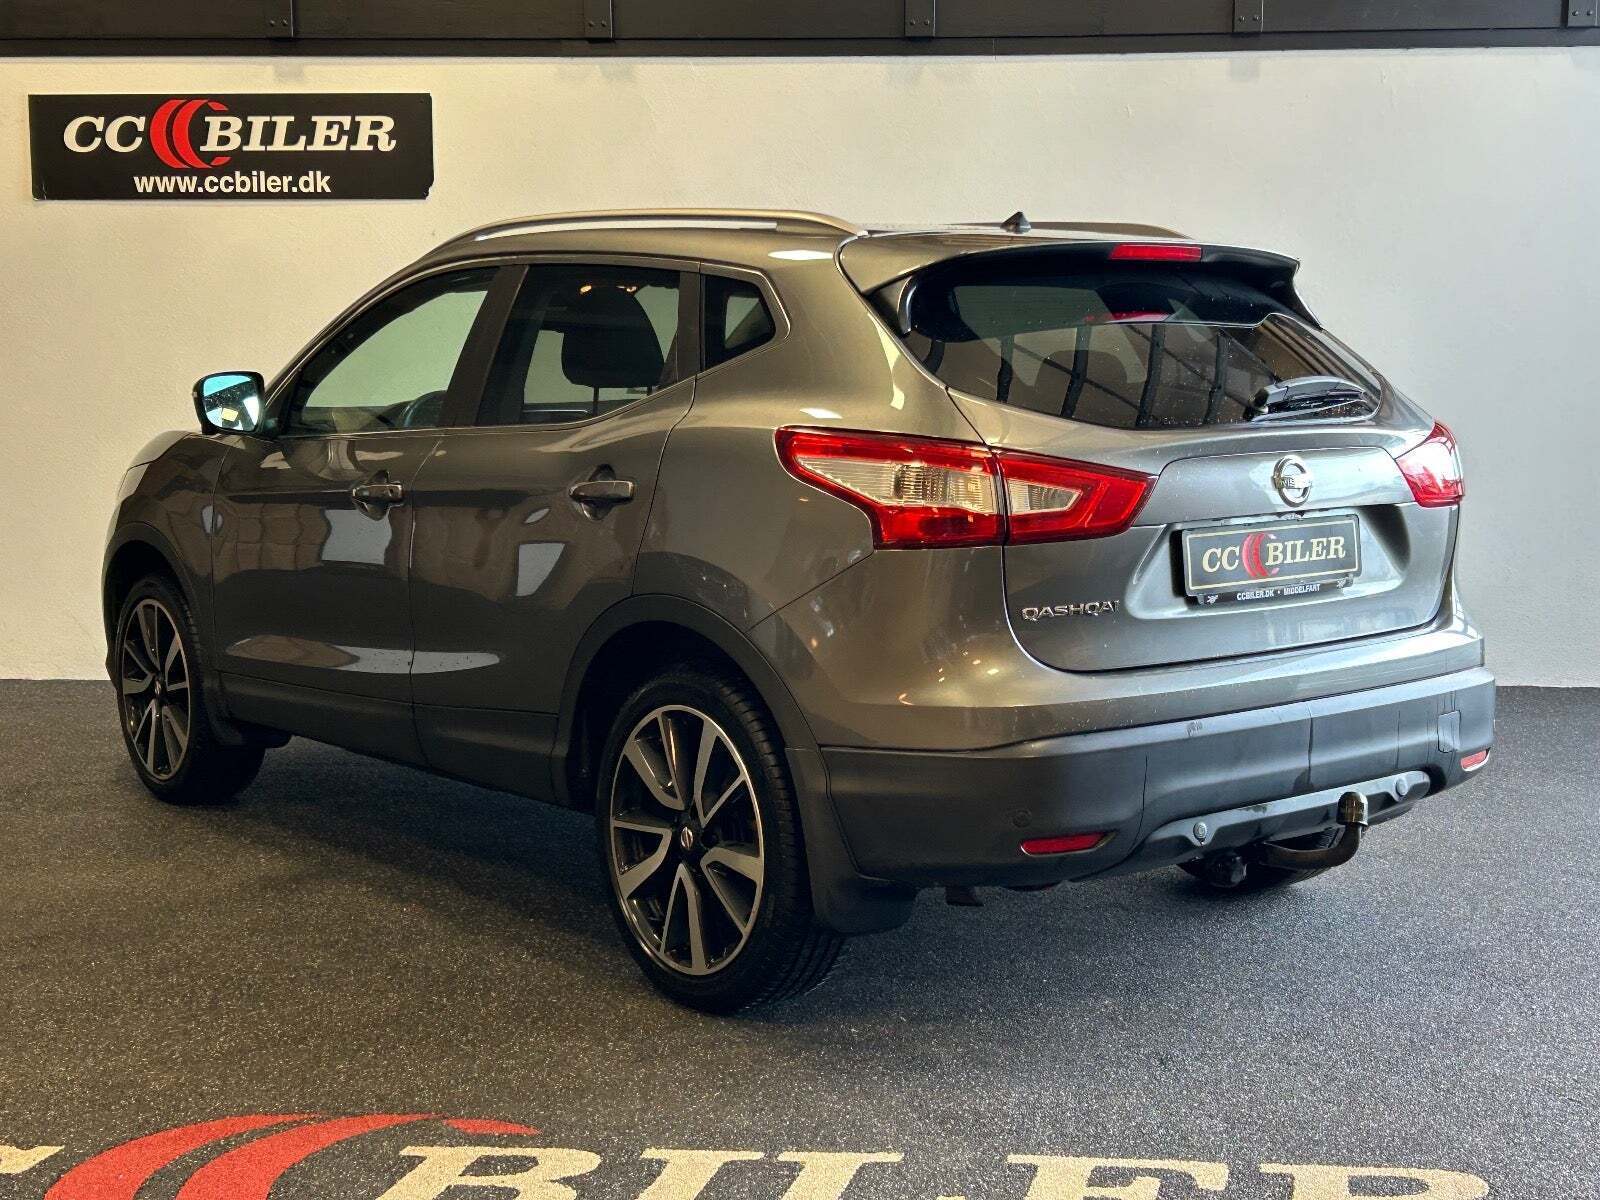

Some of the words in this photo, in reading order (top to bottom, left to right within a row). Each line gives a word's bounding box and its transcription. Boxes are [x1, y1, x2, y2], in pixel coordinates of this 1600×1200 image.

[63, 115, 146, 153] CC
[199, 115, 397, 153] BILER
[133, 171, 332, 194] www.ccbiler.dk
[1202, 546, 1240, 573] CC
[1265, 535, 1347, 566] BILER
[1236, 589, 1275, 601] CCBILER.DK
